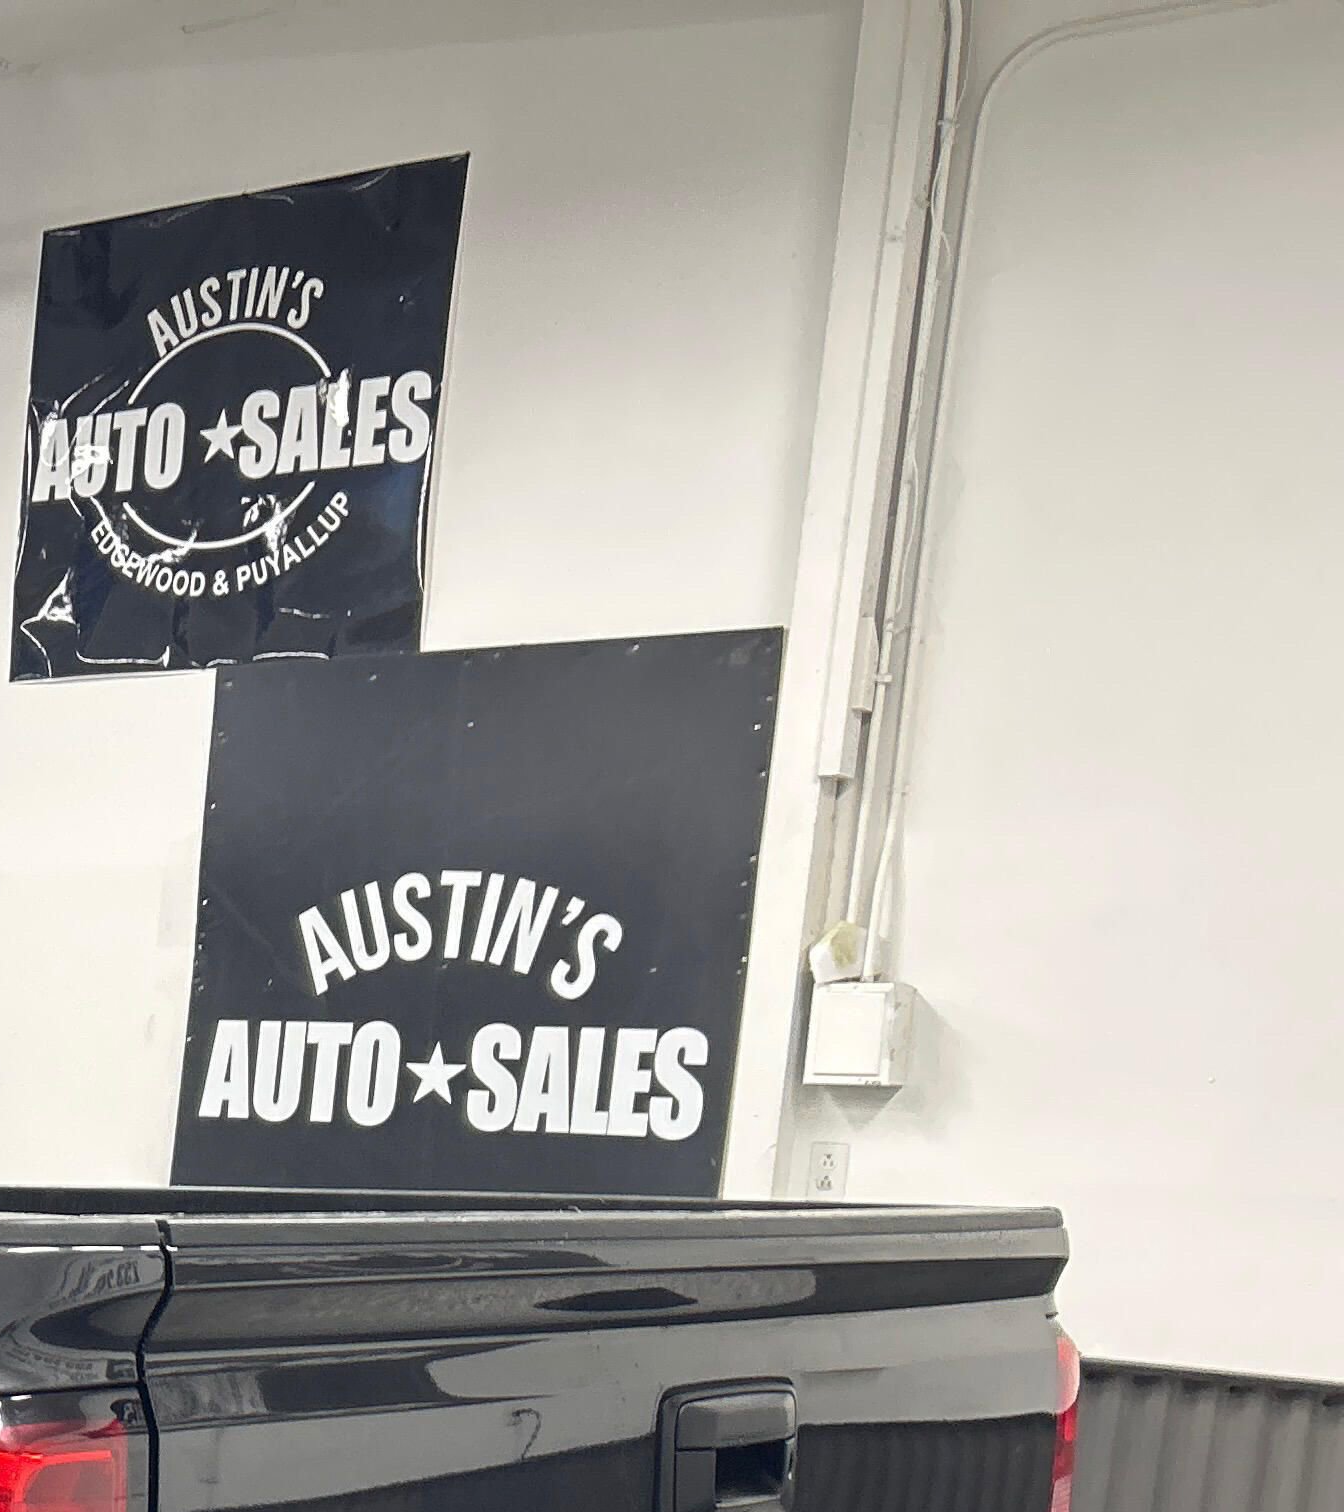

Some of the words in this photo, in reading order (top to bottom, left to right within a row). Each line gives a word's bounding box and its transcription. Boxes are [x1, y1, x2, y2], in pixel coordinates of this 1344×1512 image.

[146, 266, 324, 359] AUSTIN'S
[32, 402, 185, 503] AUTO
[237, 370, 432, 480] SALES
[90, 519, 206, 597] EDGEWOOD
[212, 569, 229, 597] &
[235, 491, 350, 592] PUYALLUP
[298, 868, 623, 1000] AUSTIN'S
[198, 1019, 401, 1127] AUTO
[467, 1022, 709, 1141] SALES
